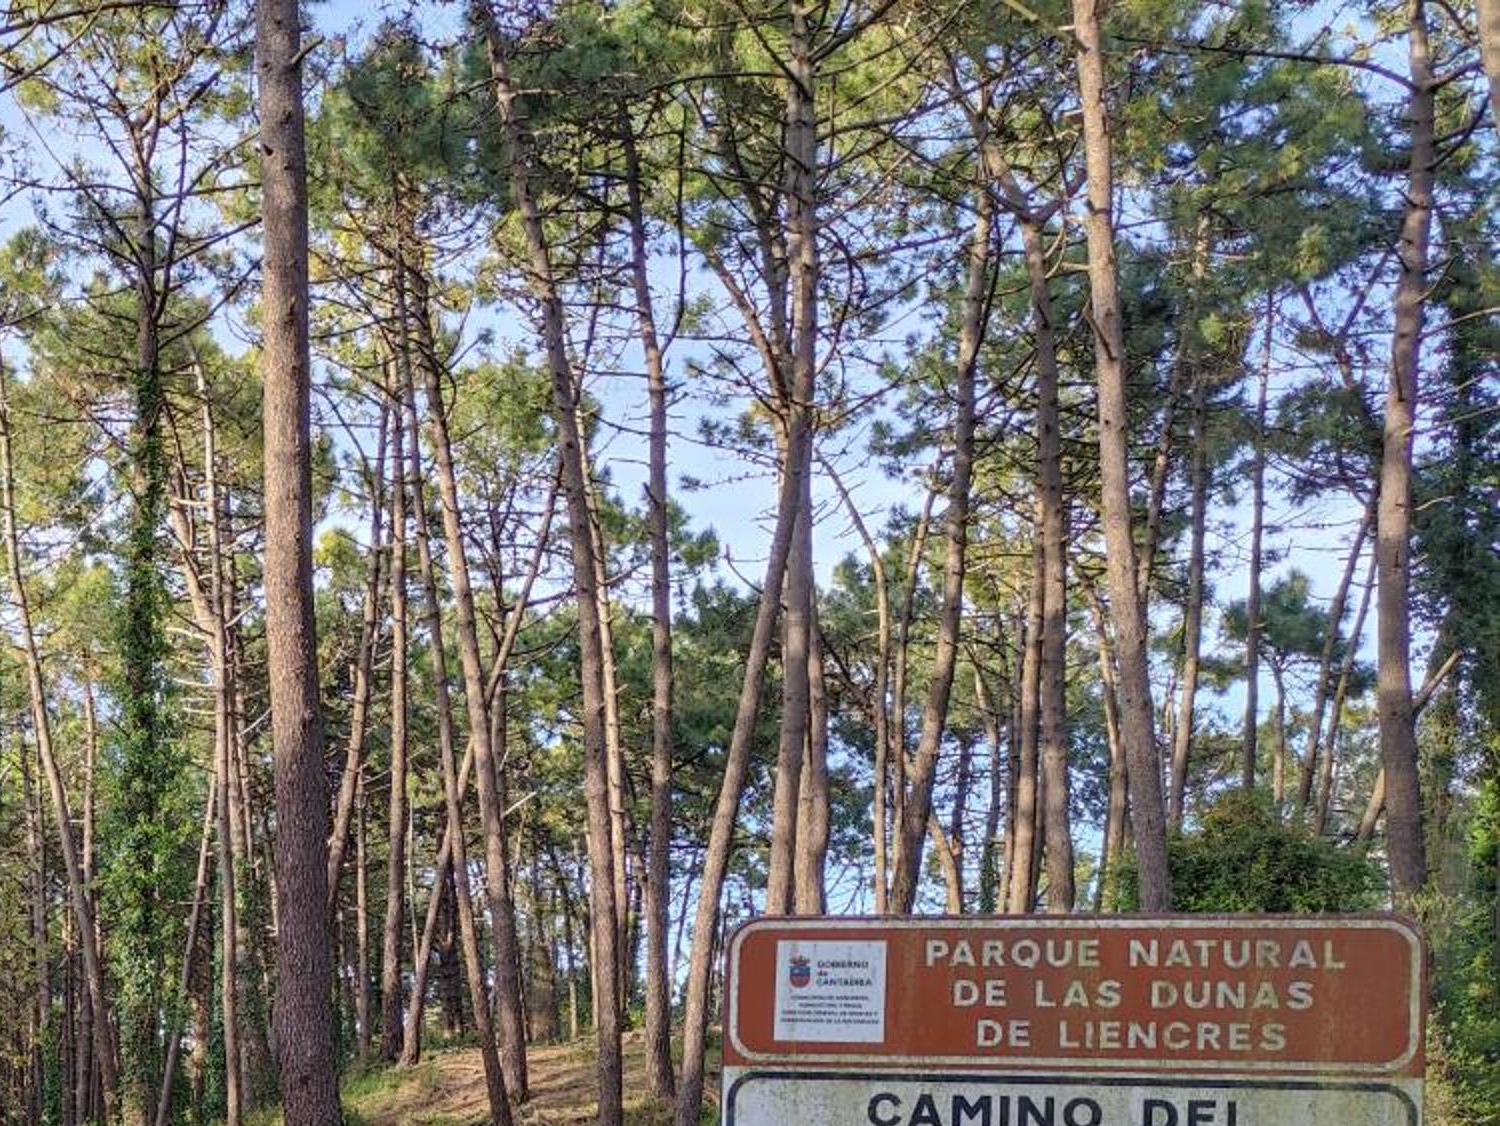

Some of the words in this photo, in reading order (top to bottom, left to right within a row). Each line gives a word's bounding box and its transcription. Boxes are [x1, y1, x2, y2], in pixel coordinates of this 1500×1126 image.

[925, 939, 1100, 970] PARQUE
[1129, 939, 1346, 970] NATURAL
[952, 979, 1007, 1007] DE
[1035, 979, 1122, 1009] LAS
[1150, 980, 1314, 1010] DUNAS
[976, 1019, 1031, 1048] DE
[1059, 1020, 1287, 1051] LIENCRES
